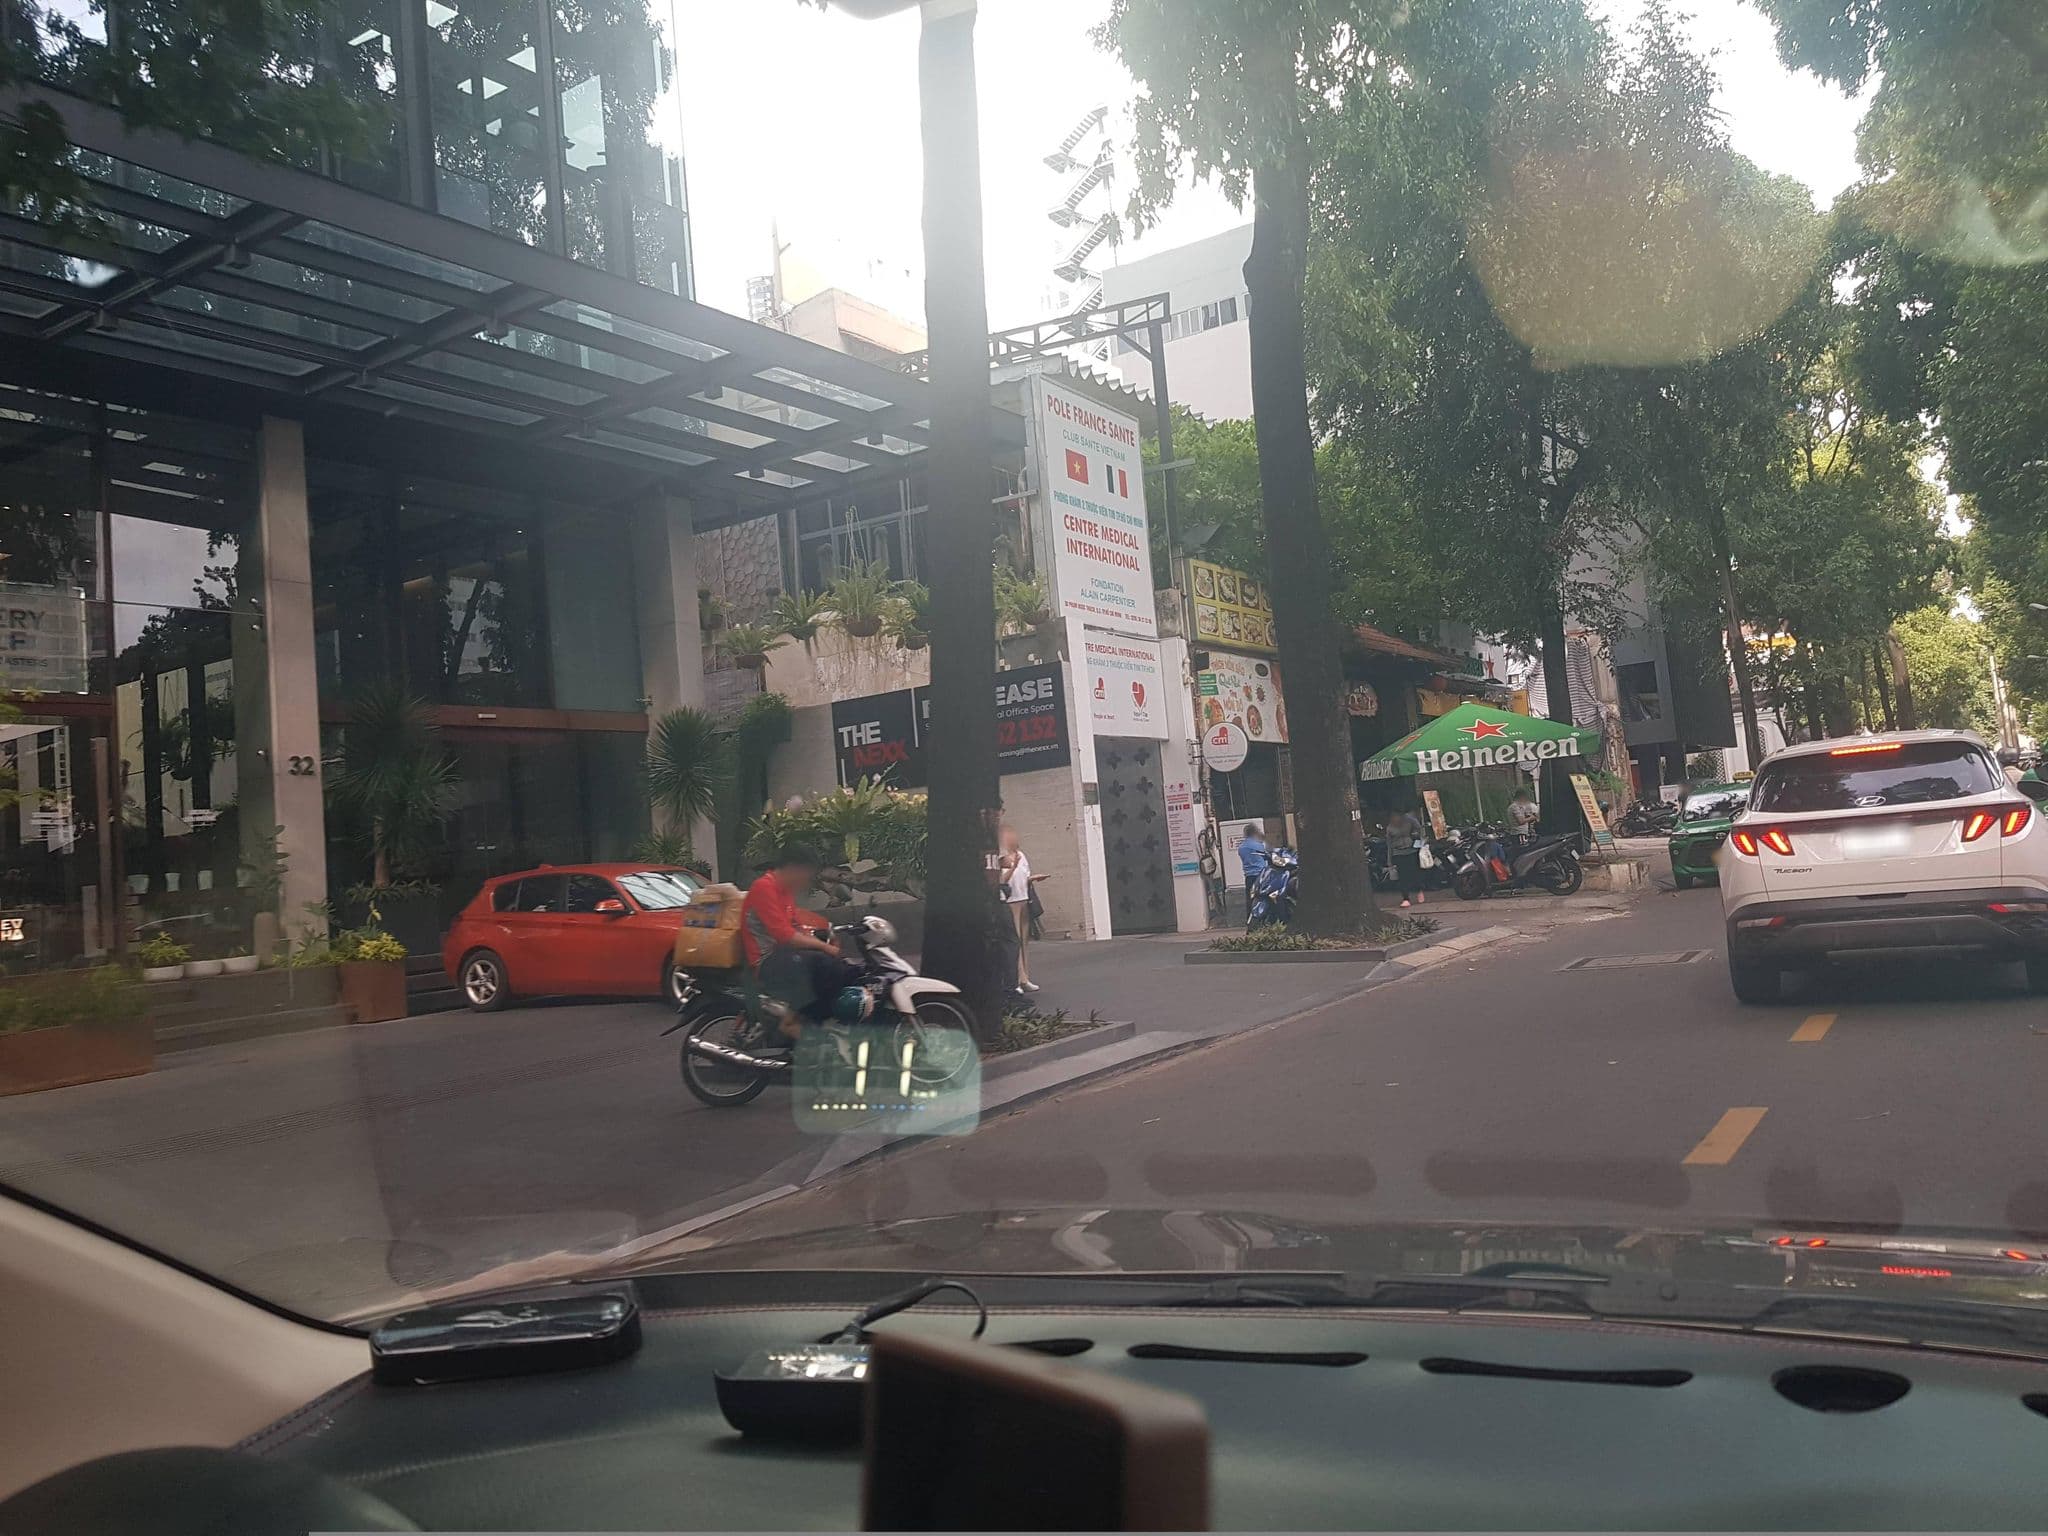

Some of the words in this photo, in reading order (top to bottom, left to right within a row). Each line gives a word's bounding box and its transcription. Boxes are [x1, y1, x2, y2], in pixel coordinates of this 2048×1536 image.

[1047, 394, 1071, 420] POLE
[1073, 406, 1106, 435] FRANCE
[1108, 421, 1135, 447] SANTE
[1062, 429, 1080, 444] CLUB
[1080, 436, 1100, 452] SANTE
[1100, 443, 1126, 461] VIETNAM
[1063, 514, 1099, 539] CENTRE
[1101, 525, 1139, 550] MEDICAL
[1066, 537, 1140, 572] INTERNATIONAL
[1080, 588, 1099, 600] ALAIN
[1100, 592, 1136, 608] CARPENTIER
[1091, 578, 1124, 593] FONDATION
[1094, 644, 1118, 656] MEDICAL
[1118, 647, 1156, 662] INTERNATIONAL
[1005, 706, 1029, 718] Office
[1030, 703, 1055, 714] Space
[838, 721, 881, 748] THE
[288, 755, 315, 775] 32
[1413, 736, 1581, 774] Heineken
